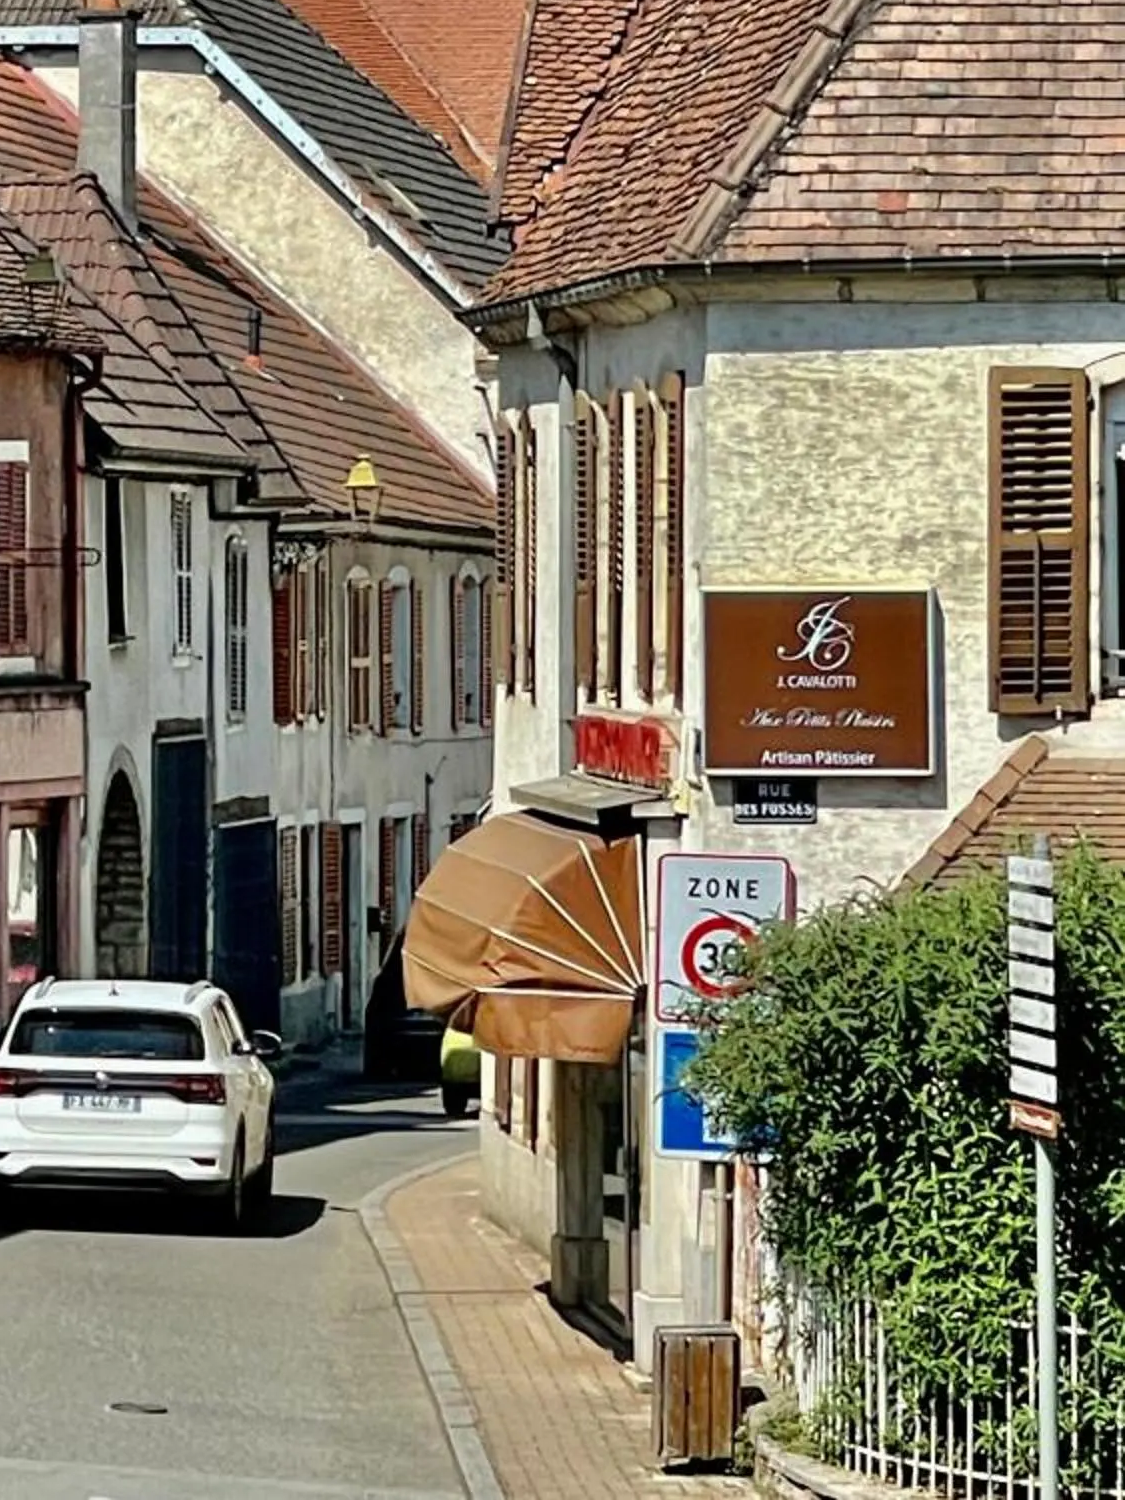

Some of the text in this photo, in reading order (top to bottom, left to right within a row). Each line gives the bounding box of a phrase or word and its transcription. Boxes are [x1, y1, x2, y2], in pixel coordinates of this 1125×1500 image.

[787, 675, 856, 689] CAVALOTTI
[761, 750, 876, 766] Artisan Pâtissier
[758, 783, 791, 797] RUE
[735, 803, 758, 816] DES
[688, 877, 759, 899] ZONE
[699, 942, 746, 977] 30
